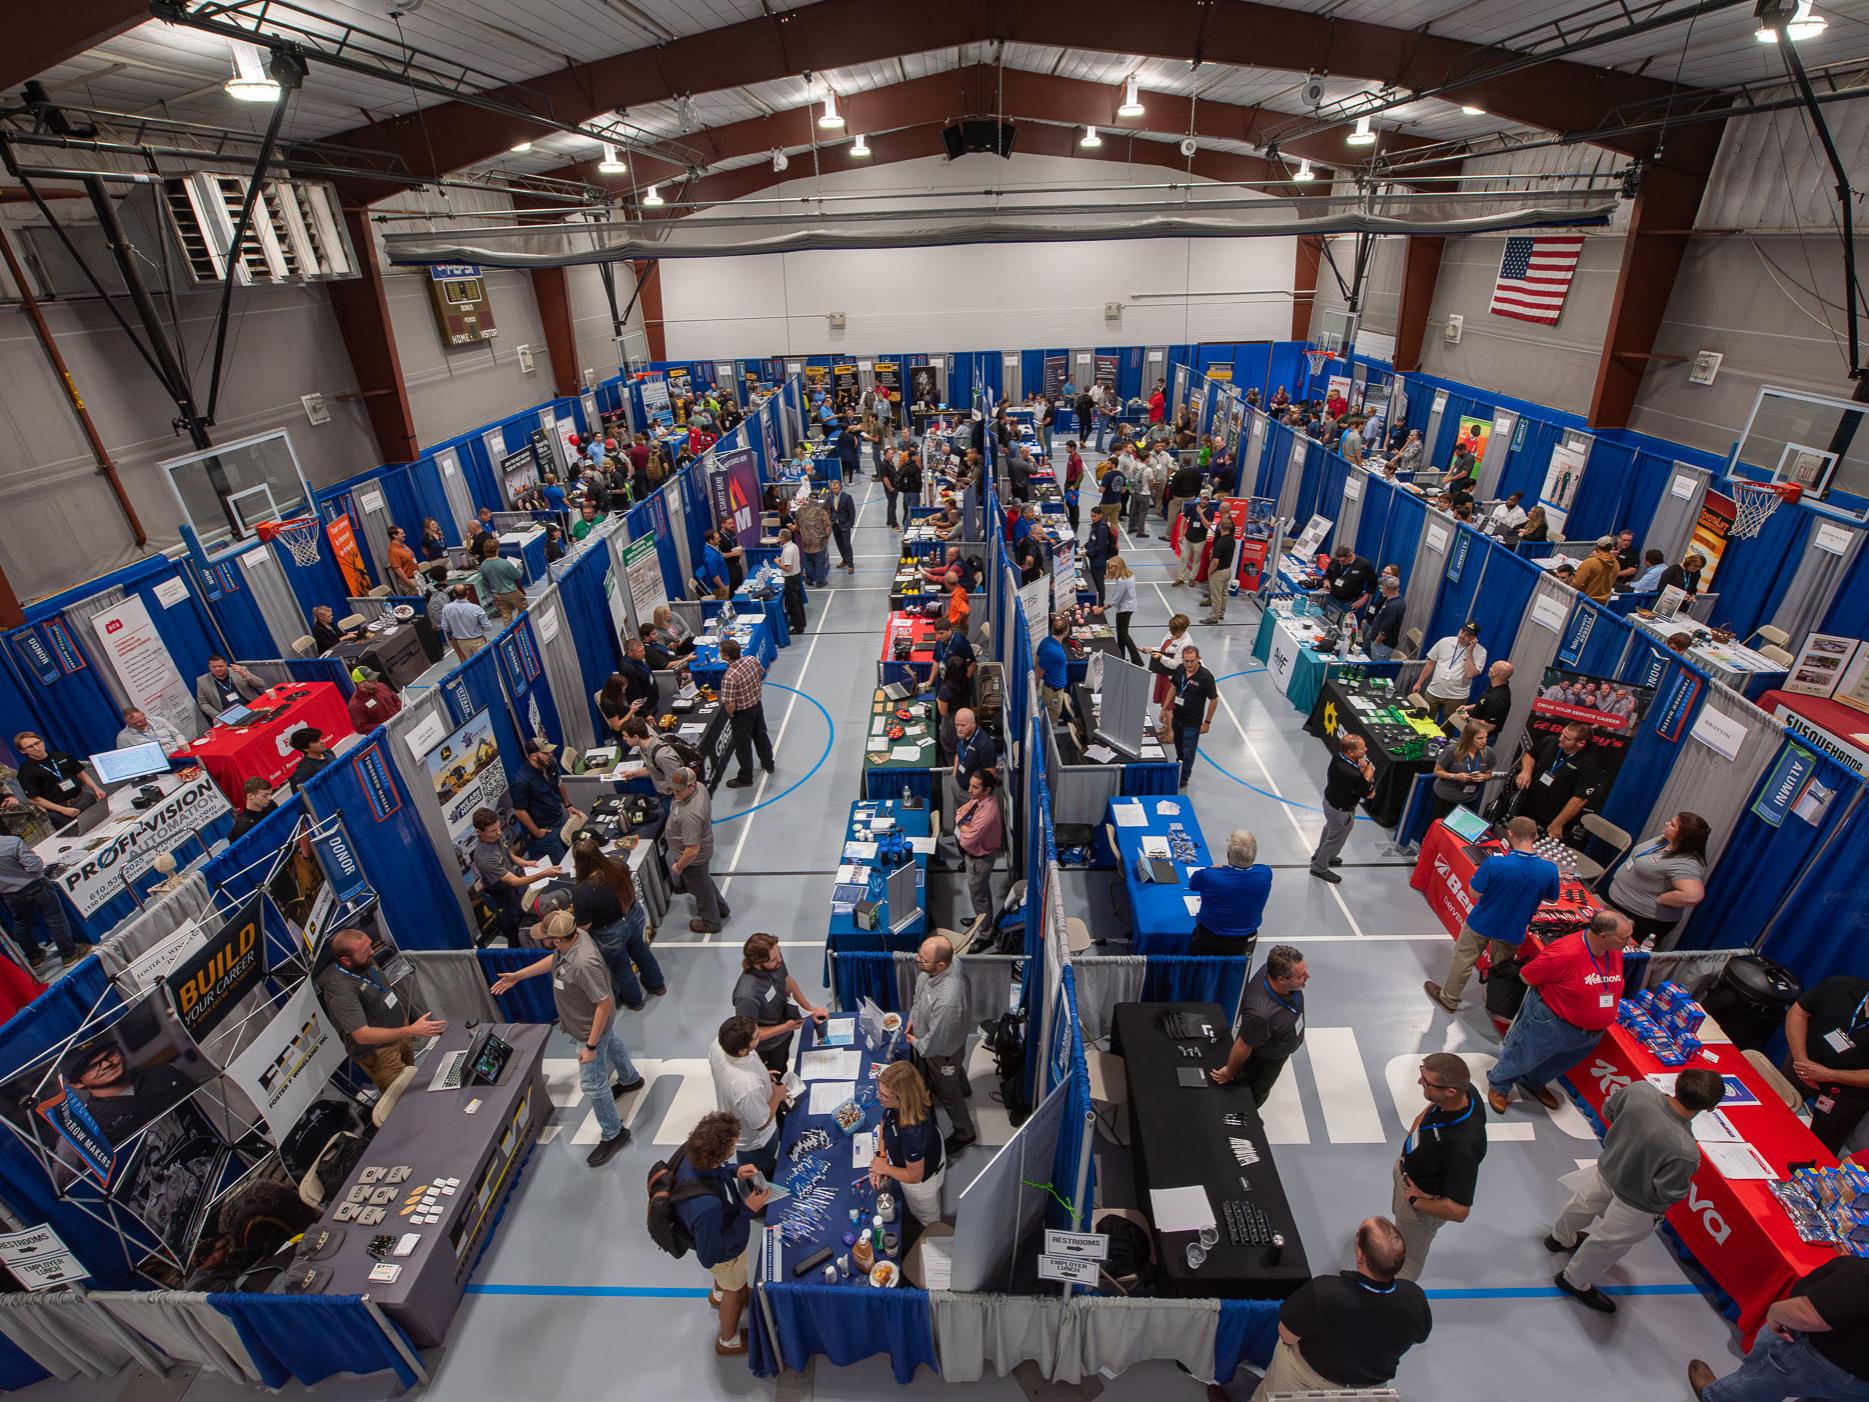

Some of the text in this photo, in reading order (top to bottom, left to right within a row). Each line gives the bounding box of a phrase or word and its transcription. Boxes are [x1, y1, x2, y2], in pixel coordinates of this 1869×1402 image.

[452, 328, 498, 344] HOME VISITOR
[1570, 614, 1588, 650] CONNECTION
[1579, 617, 1593, 643] VETERAN
[28, 638, 49, 665] DONOR
[508, 645, 520, 674] DONOR
[1537, 702, 1621, 725] DRIVE YOUR SERVICE CAREER
[1660, 679, 1690, 733] TOMORROW MAKERS
[1785, 713, 1864, 772] SUSQUEHANNA
[364, 755, 391, 814] TOMORROW MAKERS
[1773, 760, 1803, 807] ALUMNI
[127, 790, 219, 861] AUTOMATION
[329, 836, 356, 876] DONOR
[179, 922, 256, 1014] BUILD
[185, 990, 215, 1025] YOUR
[216, 950, 255, 995] CAREER
[268, 1084, 290, 1109] FOSTER
[292, 1044, 321, 1079] WINELAND
[318, 1032, 329, 1046] INC
[60, 1100, 112, 1169] TOMORROW MAKERS
[1052, 1237, 1101, 1246] RESTROOMS
[24, 1258, 64, 1273] EMPLOYER
[36, 1266, 62, 1276] LUNCH
[1050, 1259, 1087, 1270] EMPLOYER
[1057, 1265, 1081, 1273] LUNCH
